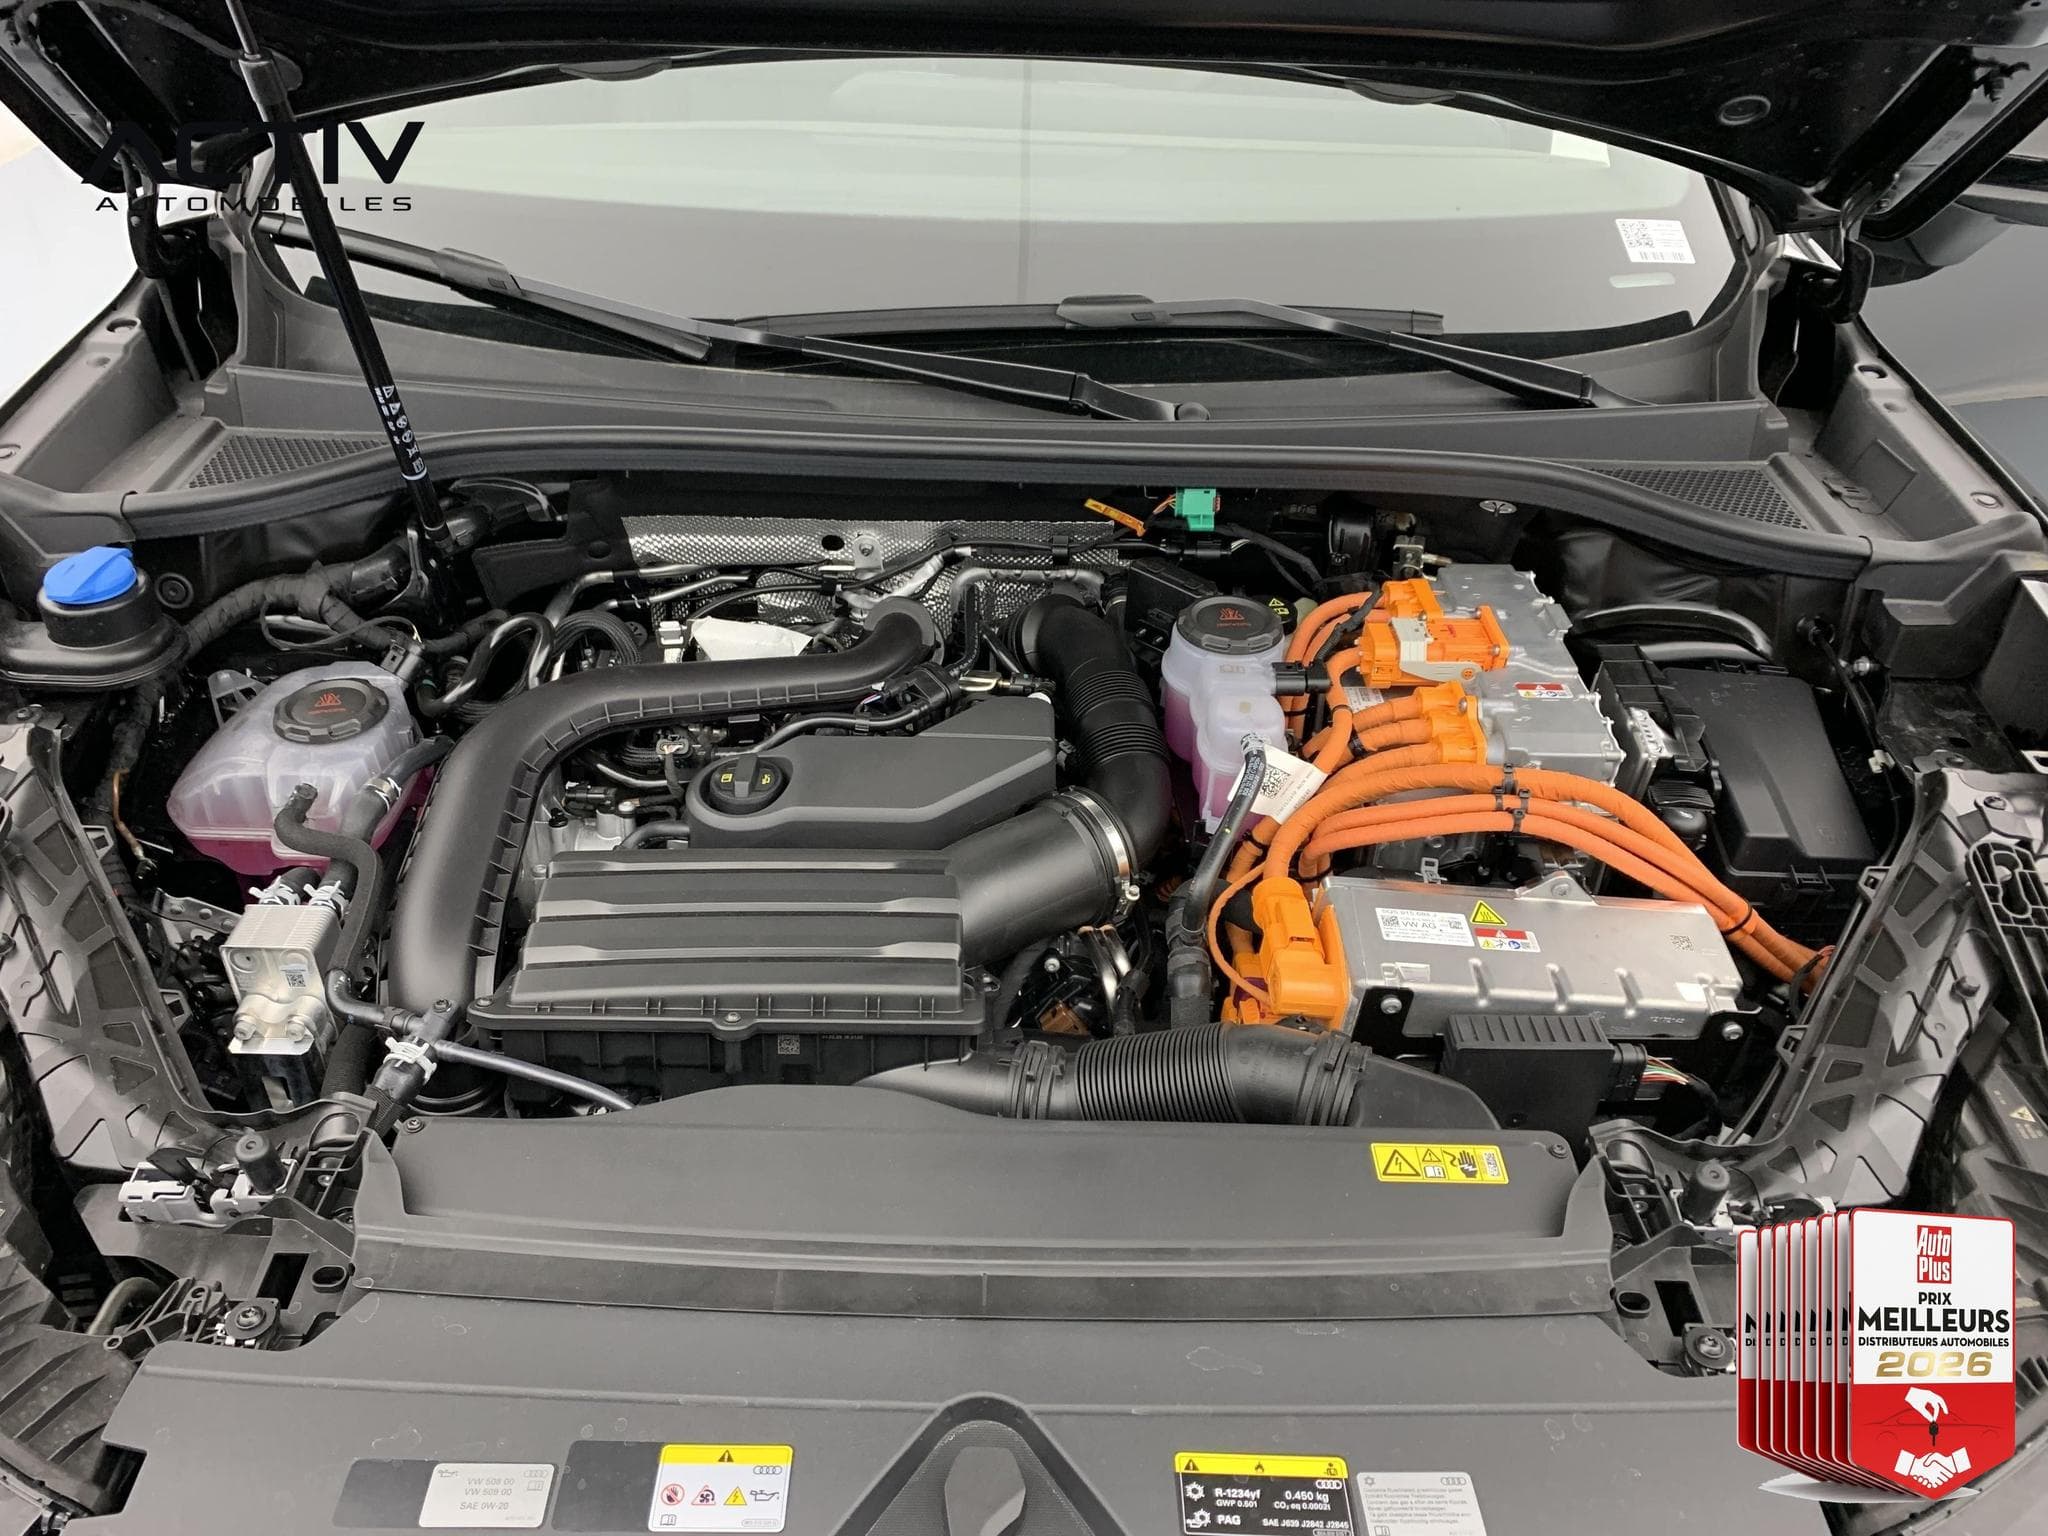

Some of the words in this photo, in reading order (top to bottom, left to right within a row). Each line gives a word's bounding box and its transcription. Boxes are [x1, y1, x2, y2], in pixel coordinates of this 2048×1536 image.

[1401, 920, 1418, 928] VW
[1214, 1488, 1261, 1500] R-1234yf
[1285, 1490, 1314, 1501] 0.450
[1316, 1491, 1330, 1503] kg
[459, 1502, 479, 1510] SAE
[1216, 1499, 1236, 1507] GWP
[1216, 1514, 1241, 1525] PAG
[1262, 1518, 1280, 1527] SAE
